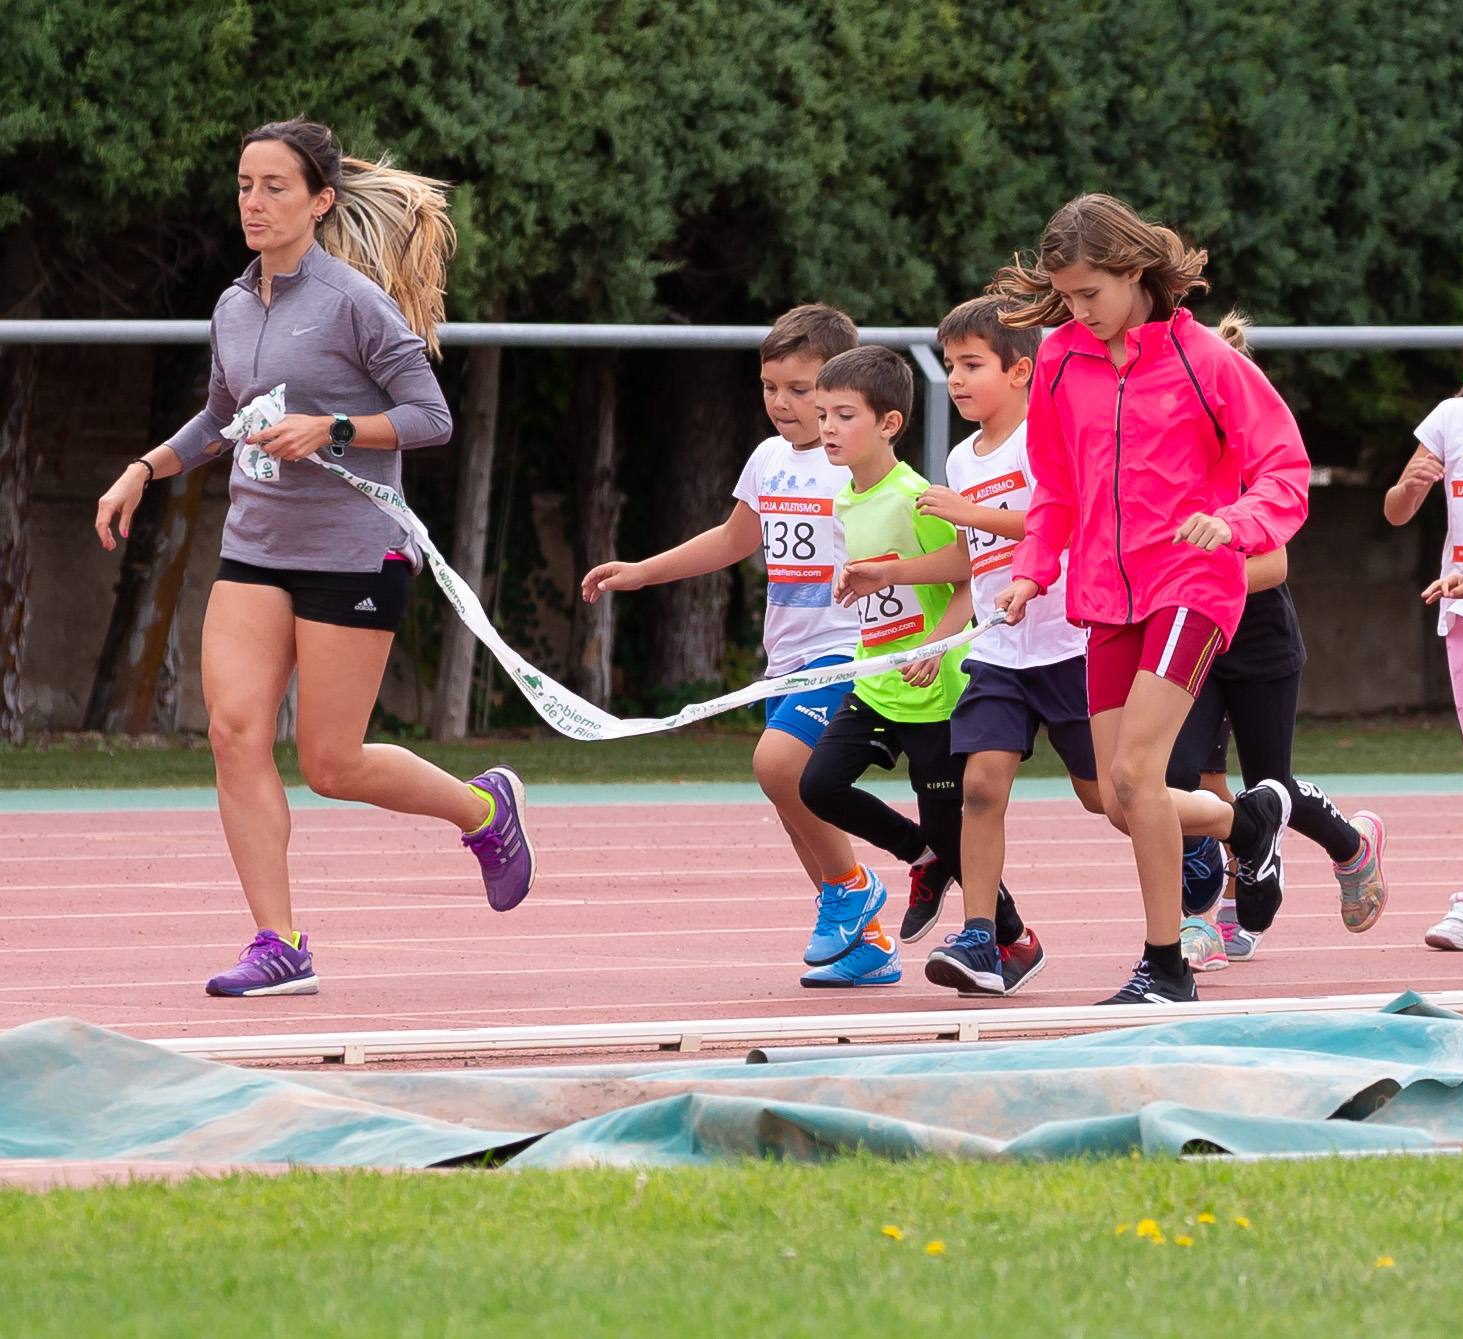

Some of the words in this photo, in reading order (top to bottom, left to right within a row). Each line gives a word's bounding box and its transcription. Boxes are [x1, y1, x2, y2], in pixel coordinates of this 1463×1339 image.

[357, 480, 372, 494] de
[374, 486, 389, 501] La
[778, 502, 821, 513] ATLETISMO
[762, 521, 816, 560] 438
[543, 703, 558, 718] de
[556, 717, 572, 732] La
[547, 695, 603, 731] Gobierno
[926, 781, 955, 790] KIPSTA
